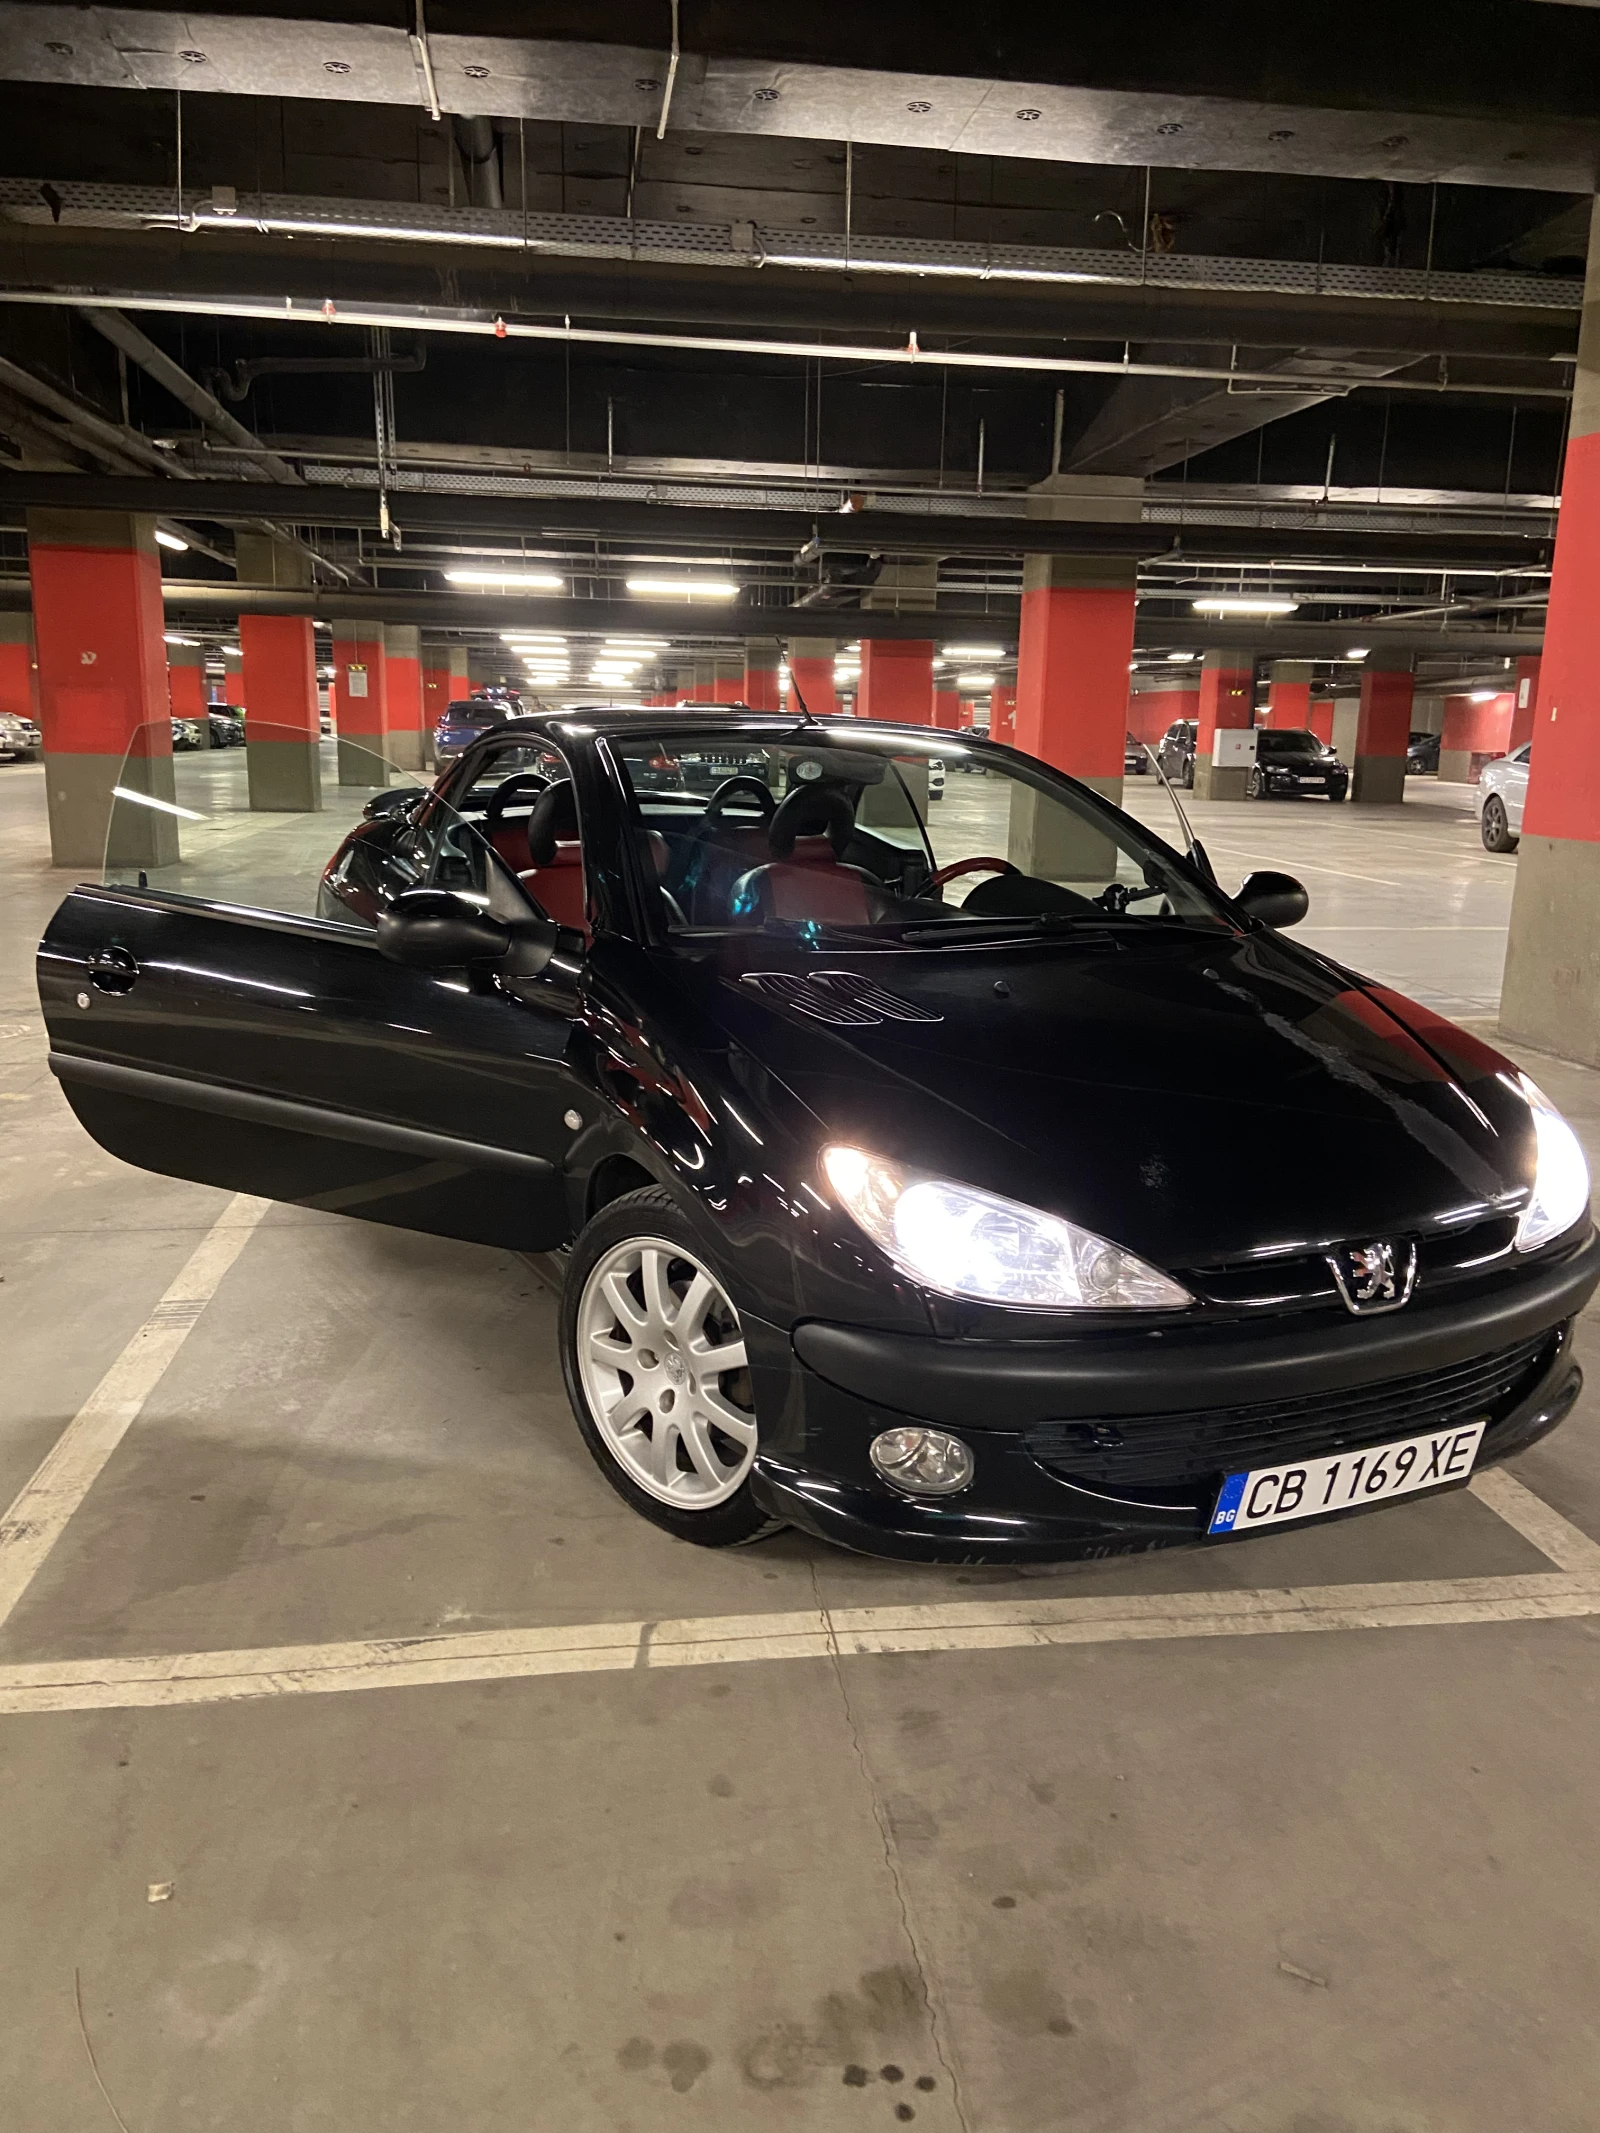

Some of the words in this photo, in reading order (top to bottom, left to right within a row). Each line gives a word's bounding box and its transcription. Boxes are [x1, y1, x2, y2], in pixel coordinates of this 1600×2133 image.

[1246, 1469, 1307, 1519] CB
[1322, 1445, 1418, 1505] 1169
[1419, 1430, 1477, 1482] XE
[1215, 1509, 1236, 1525] BG
